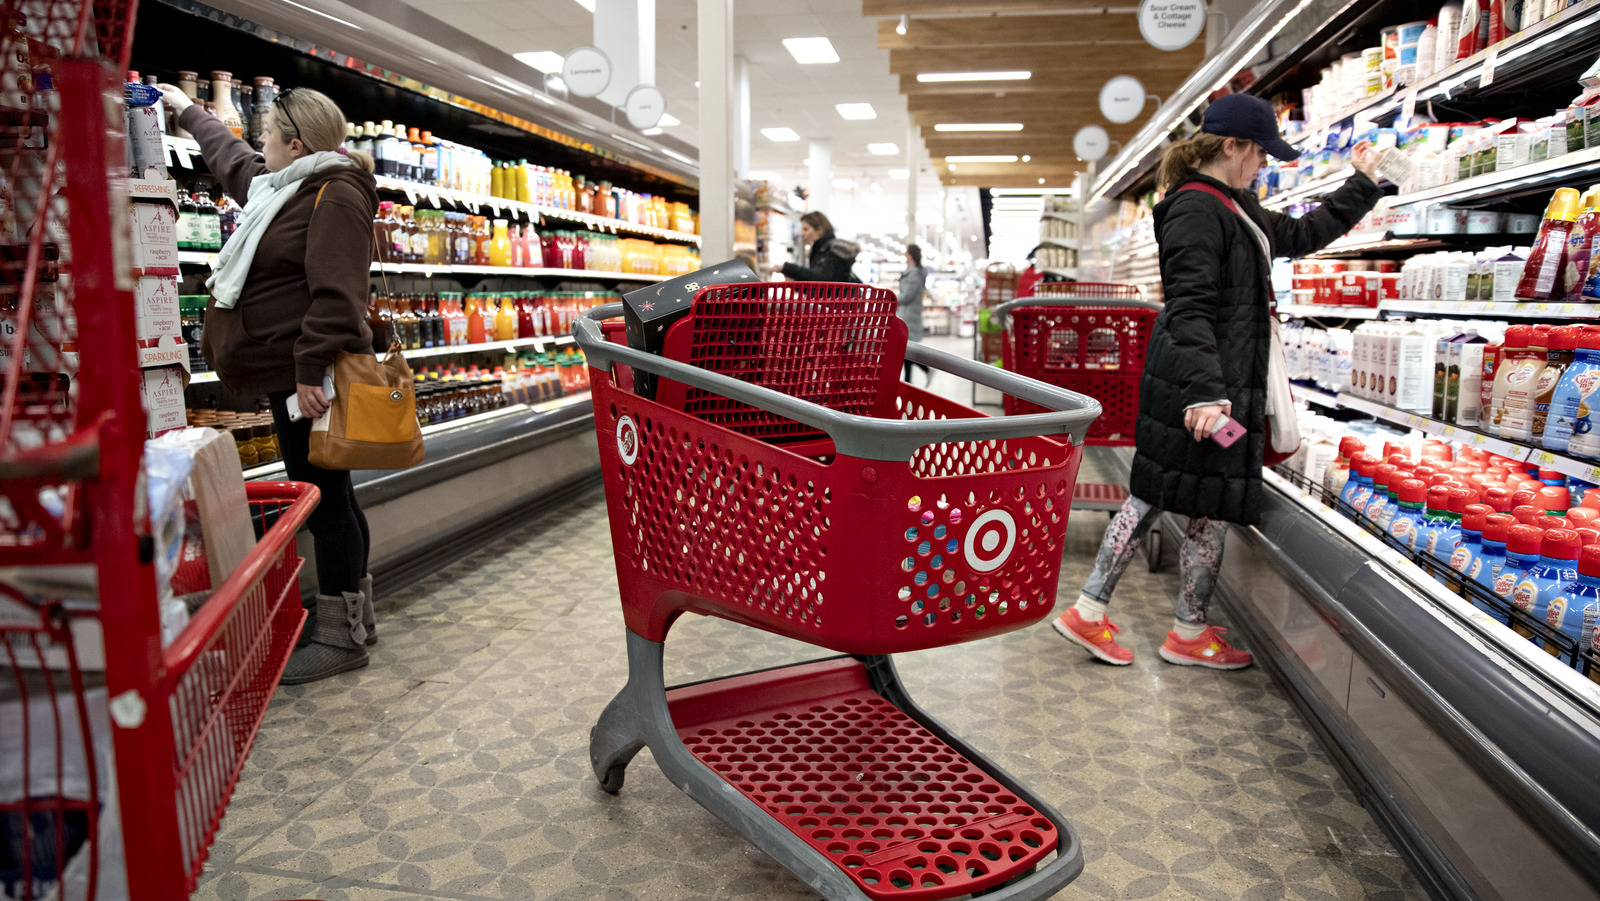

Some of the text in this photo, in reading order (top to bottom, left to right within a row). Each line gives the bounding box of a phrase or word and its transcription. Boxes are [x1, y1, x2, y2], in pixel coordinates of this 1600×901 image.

[134, 184, 170, 194] REFRESHING
[144, 225, 170, 233] ASPIRE
[150, 248, 171, 256] raspberry
[144, 350, 182, 363] SPARKLING
[153, 388, 178, 398] ASPIRE
